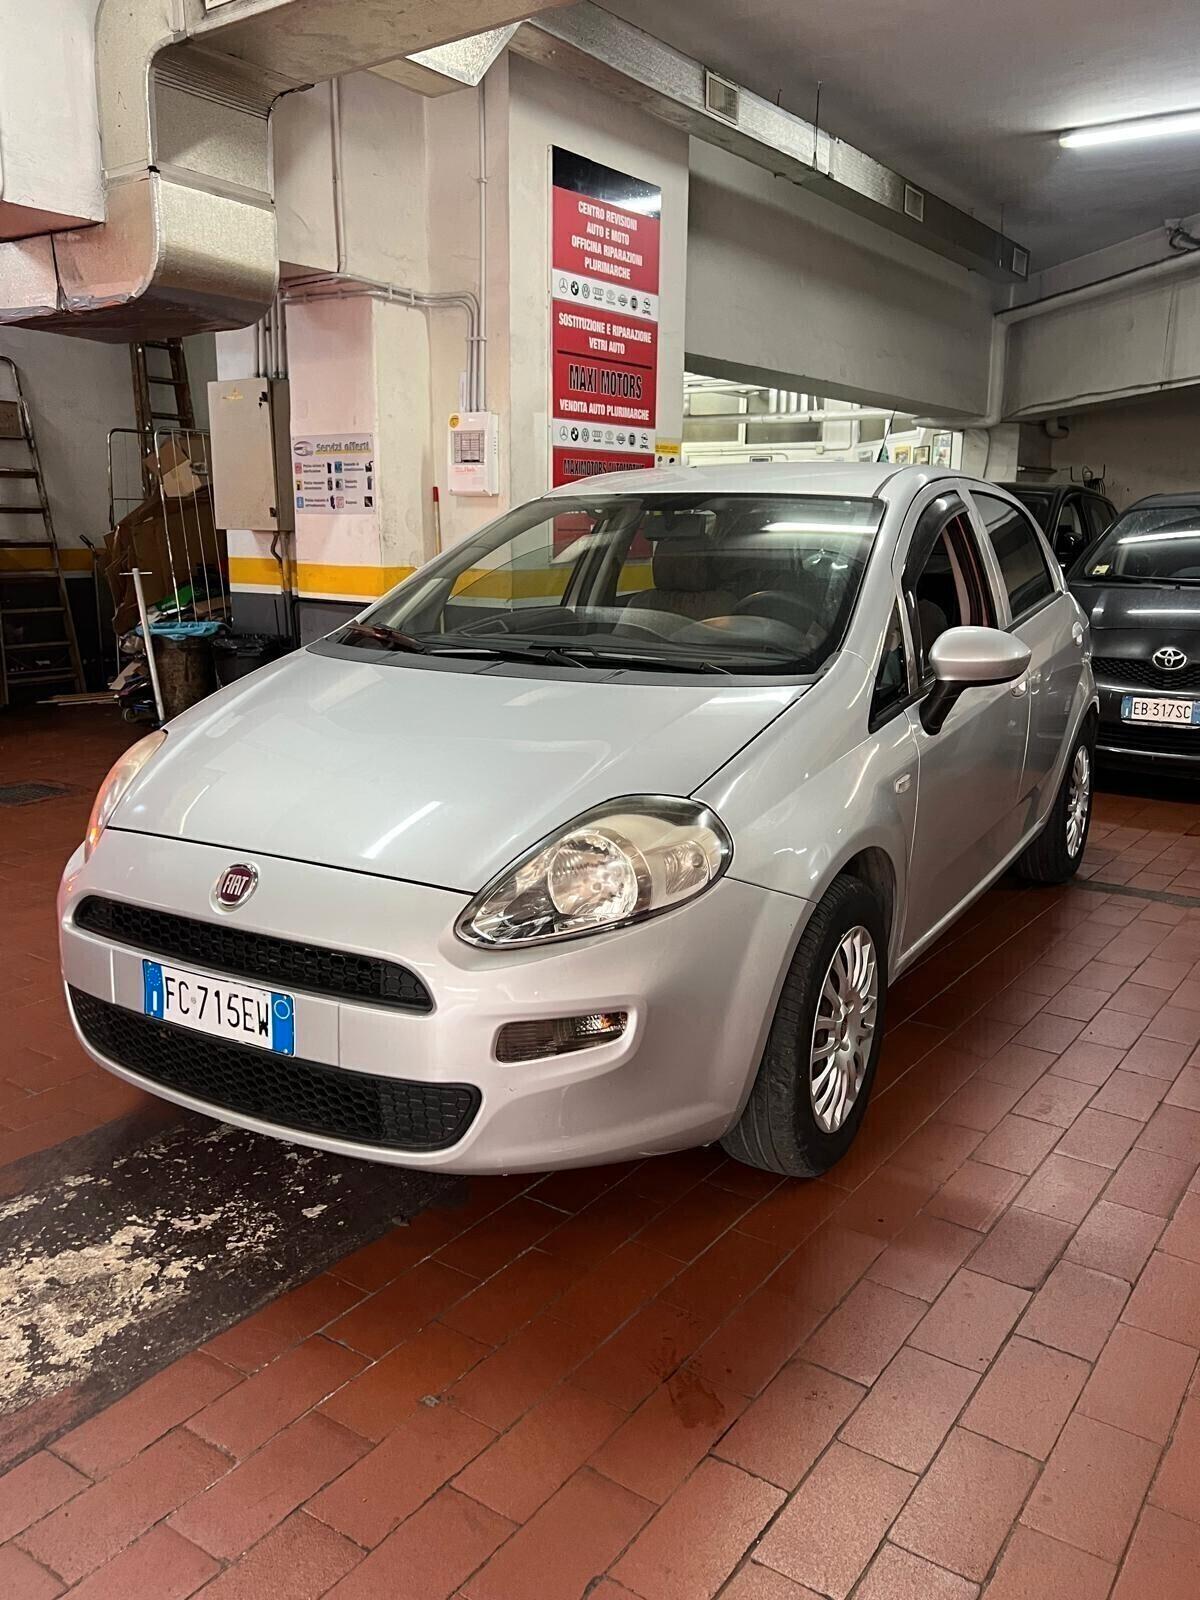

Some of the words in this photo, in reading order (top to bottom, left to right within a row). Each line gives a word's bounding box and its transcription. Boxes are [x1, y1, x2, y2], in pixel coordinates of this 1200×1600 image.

[578, 200, 605, 220] CENTRO
[605, 210, 638, 231] REVISIONI
[586, 221, 603, 240] AUTO
[605, 230, 610, 240] E
[611, 231, 630, 246] MOTO
[571, 235, 602, 255] OFFICINA
[603, 244, 643, 267] RIPARAZIONI
[584, 256, 631, 280] PLURIMARCHE
[558, 312, 606, 335] SOSTITUZIONE
[606, 324, 612, 335] E
[612, 325, 652, 344] RIPARAZIONE
[589, 336, 608, 350] VETRI
[608, 341, 626, 355] AUTO
[568, 363, 597, 393] MAXI
[600, 368, 643, 400] MOTORS
[559, 398, 588, 414] VENDITA
[588, 402, 606, 416] AUTO
[606, 404, 650, 421] PLURIMARCHE
[316, 442, 342, 452] Servizi
[344, 441, 369, 452] offerti
[563, 458, 607, 475] MAXIMOTORS
[223, 874, 249, 896] FIAT
